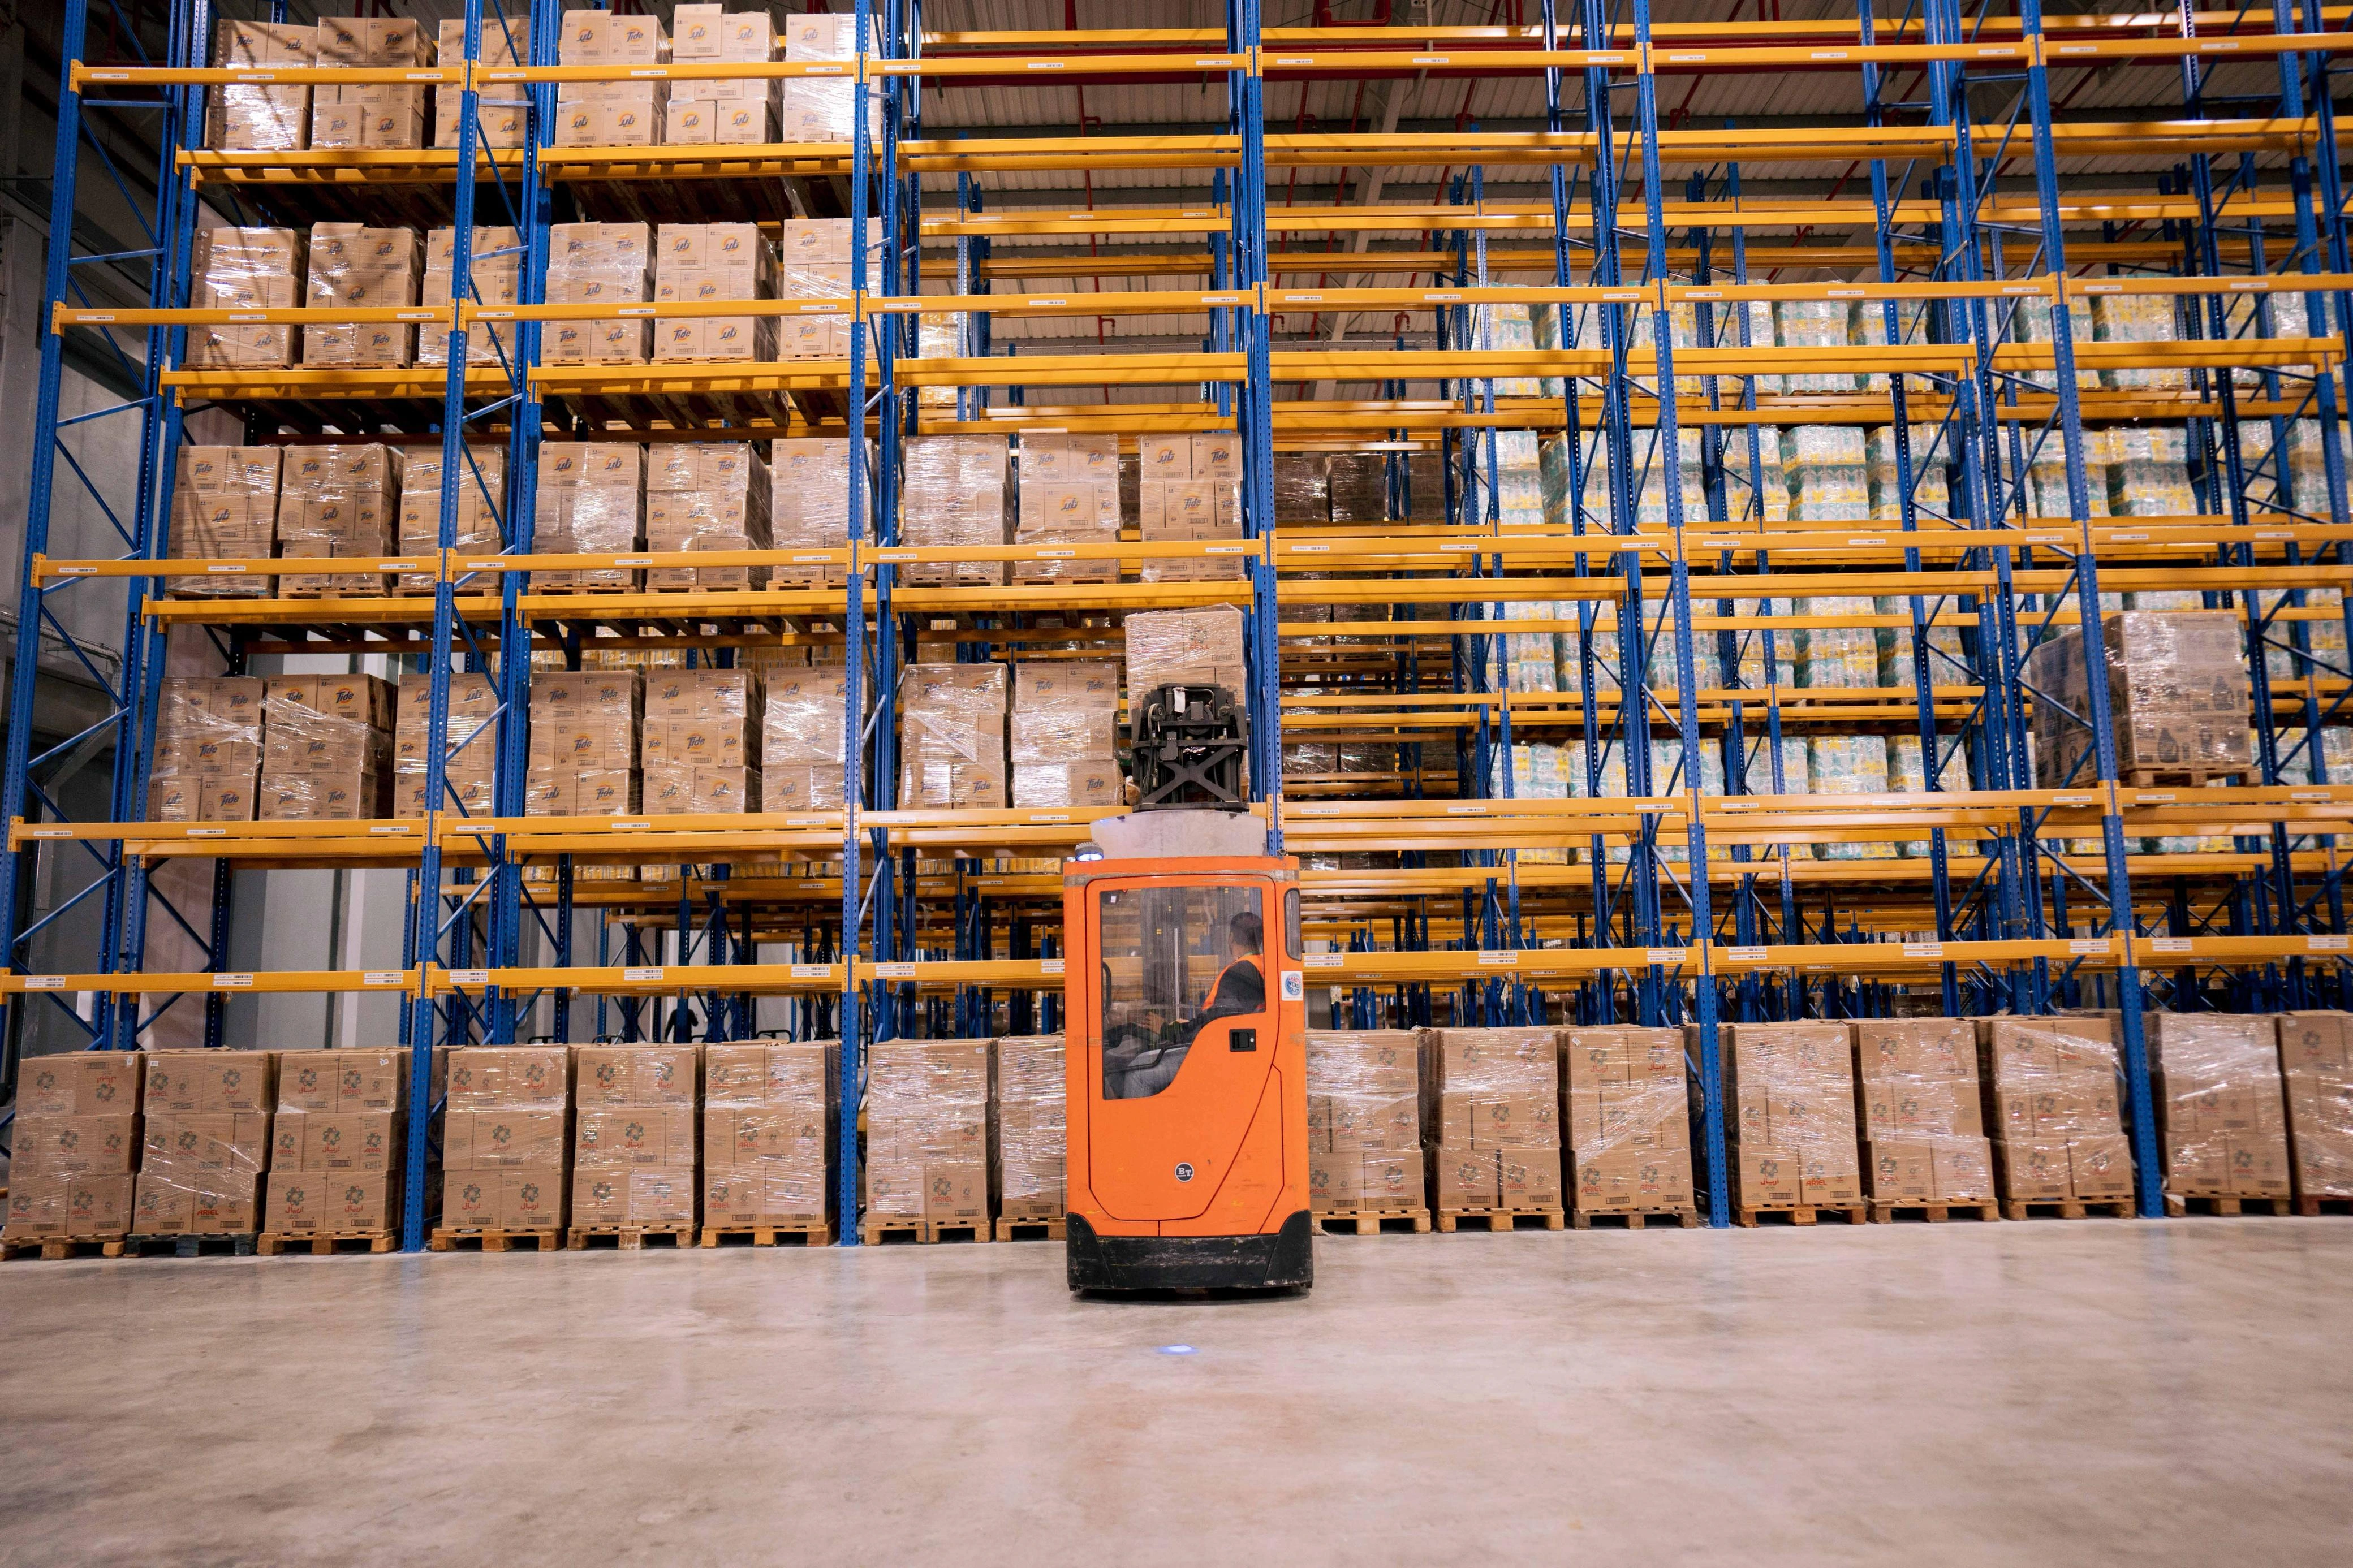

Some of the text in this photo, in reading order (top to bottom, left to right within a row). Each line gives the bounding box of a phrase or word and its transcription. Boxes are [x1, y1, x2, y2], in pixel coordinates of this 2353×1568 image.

[337, 32, 353, 44] Tide
[385, 33, 402, 45] Tide
[627, 32, 643, 42] Tide
[688, 28, 705, 40] تايد
[737, 28, 755, 40] تايد
[236, 34, 253, 47] Tide
[572, 116, 588, 128] تايد
[618, 114, 635, 127] تايد
[682, 115, 699, 127] تايد
[732, 113, 749, 125] تايد
[331, 119, 347, 132] Tide
[568, 240, 584, 252] Tide
[617, 240, 634, 250] Tide
[673, 240, 691, 252] تايد
[722, 239, 739, 252] تايد
[501, 291, 513, 300] Tide
[699, 286, 716, 297] Tide
[559, 330, 577, 342] Tide
[607, 329, 623, 342] تايد
[674, 329, 691, 340] Tide
[721, 327, 737, 340] تايد
[799, 326, 816, 336] Tide
[372, 334, 390, 345] Tide
[1038, 453, 1054, 465] Tide
[1087, 453, 1104, 465] Tide
[1157, 452, 1174, 464] تايد
[1210, 451, 1229, 463] Tide
[195, 463, 212, 475] Tide
[302, 463, 319, 474] Tide
[555, 458, 572, 472] تايد
[605, 457, 623, 470] تايد
[718, 460, 735, 472] Tide
[1061, 498, 1079, 511] تايد
[1184, 498, 1201, 509] Tide
[212, 509, 230, 522] تايد
[361, 512, 374, 521] Tide
[652, 512, 665, 520] Tide
[1035, 680, 1053, 693] Tide
[1086, 680, 1104, 692] Tide
[230, 696, 248, 707] Tide
[286, 692, 303, 702] Tide
[335, 691, 354, 703] Tide
[550, 690, 567, 702] Tide
[308, 741, 326, 754] Tide
[400, 744, 414, 753] Tide
[574, 738, 592, 751] Tide
[648, 739, 661, 749] Tide
[687, 736, 705, 749] Tide
[724, 738, 737, 747] Tide
[199, 745, 217, 757] Tide
[973, 780, 991, 793] Tide
[1086, 779, 1104, 791] Tide
[220, 793, 239, 806] Tide
[328, 792, 346, 803] Tide
[596, 787, 614, 800] Tide
[1178, 1168, 1192, 1176] BT
